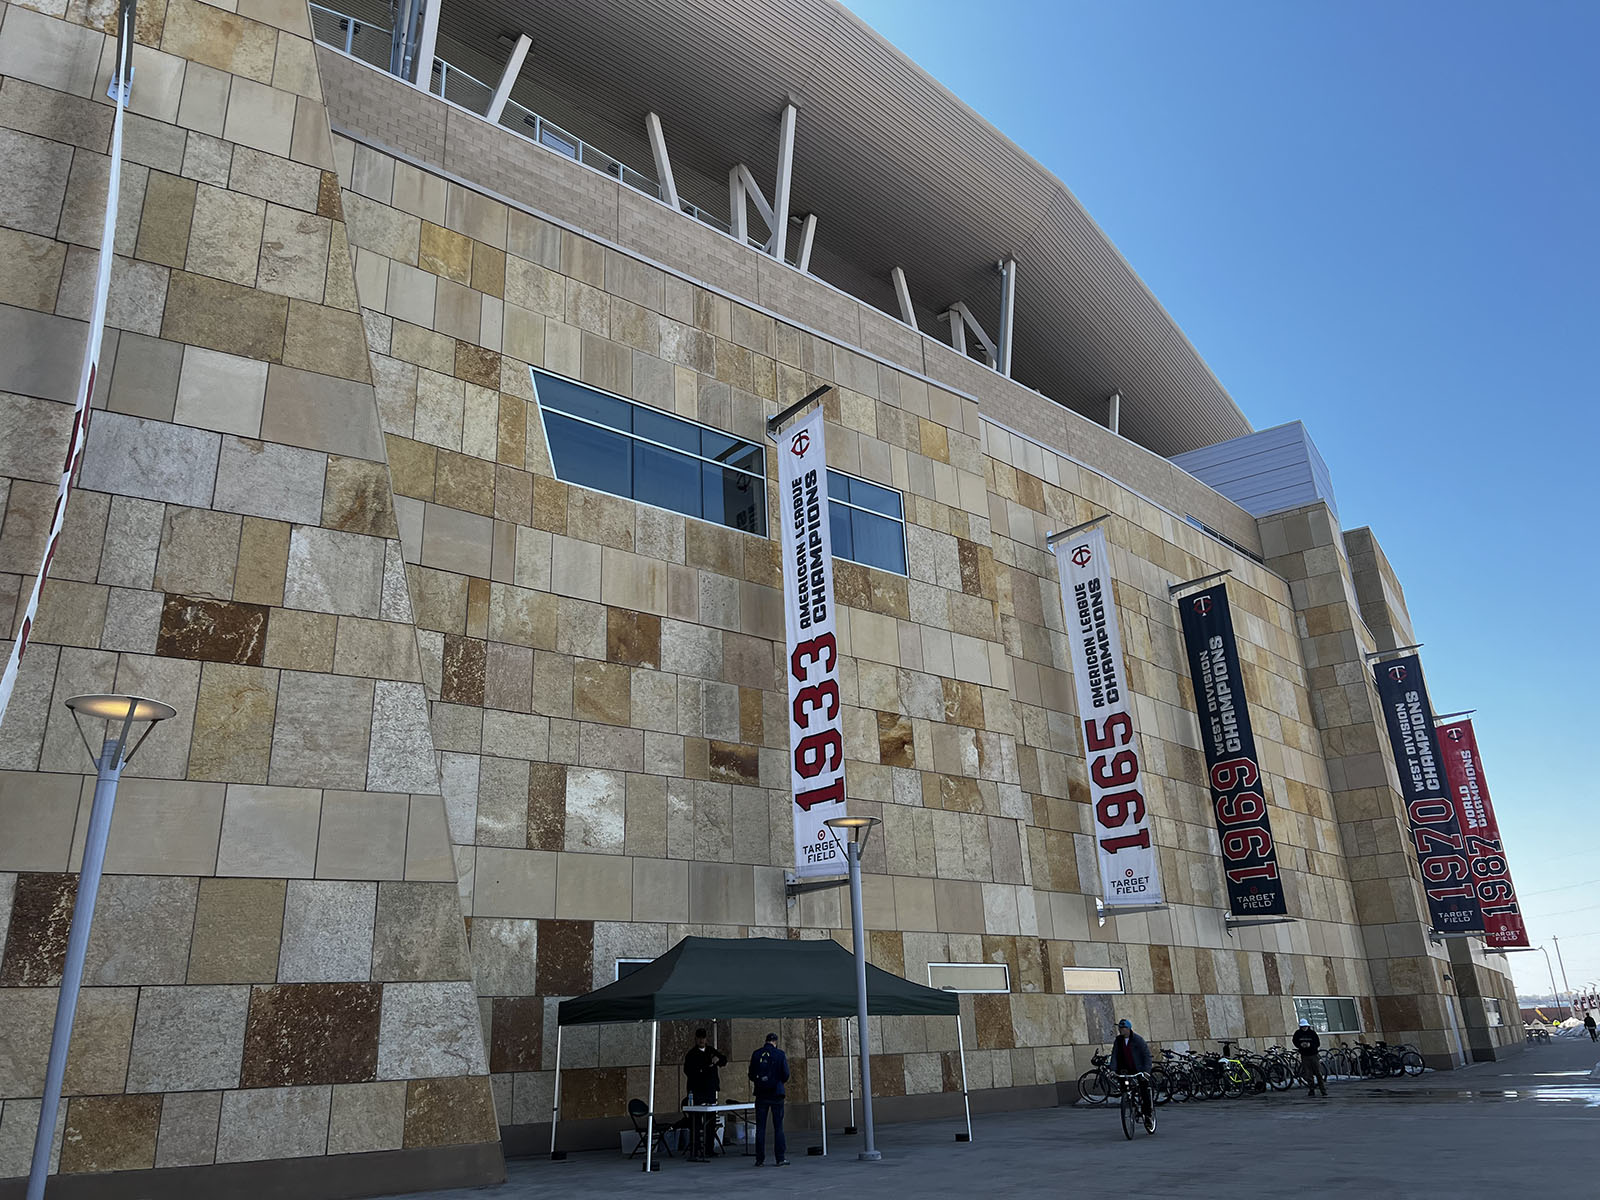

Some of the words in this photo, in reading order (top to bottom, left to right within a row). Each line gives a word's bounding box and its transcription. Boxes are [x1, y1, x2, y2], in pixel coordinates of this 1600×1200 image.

[792, 476, 805, 539] LEAGUE
[805, 468, 827, 625] CHAMPIONS
[796, 542, 811, 629] AMERICAN
[1075, 582, 1092, 634] LEAGUE
[1084, 636, 1105, 708] AMERICAN
[1088, 577, 1119, 705] CHAMPIONS
[1200, 650, 1218, 713] DIVISION
[1209, 635, 1242, 753] CHAMPIONS
[791, 631, 845, 811] 1933
[1211, 716, 1225, 756] WEST
[1395, 703, 1417, 756] DIVISION
[1405, 690, 1440, 791] CHAMPIONS
[1084, 711, 1150, 854] 1965
[1408, 759, 1425, 792] WEST
[1459, 785, 1478, 829] WORLD
[1460, 749, 1488, 828] CHAMPIONS
[803, 838, 840, 855] TARGET
[1210, 757, 1278, 884] 1969
[1408, 797, 1476, 901] 1970
[808, 849, 836, 863] FIELD
[1111, 876, 1150, 888] TARGET
[1464, 834, 1519, 917] 1987
[1116, 884, 1147, 895] FIELD
[1236, 893, 1276, 904] TARGET
[1243, 900, 1273, 910] FIELD
[1438, 910, 1474, 919] TARGET
